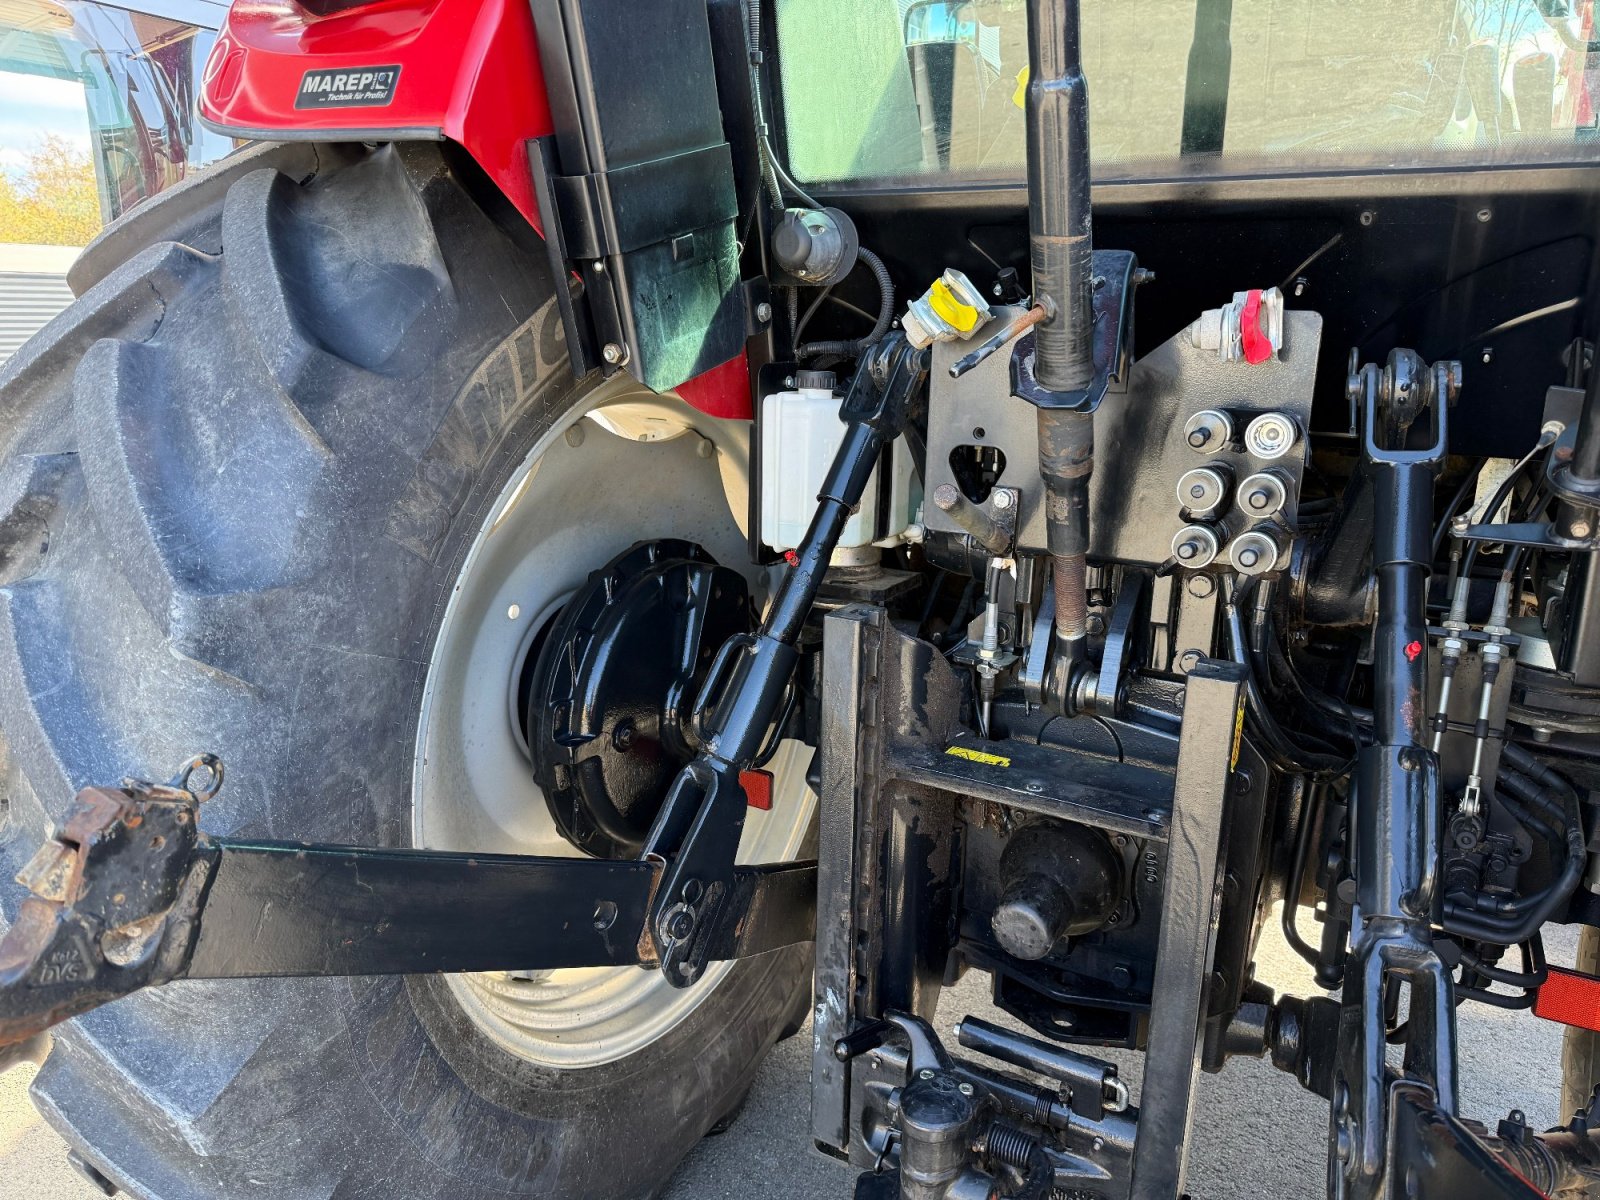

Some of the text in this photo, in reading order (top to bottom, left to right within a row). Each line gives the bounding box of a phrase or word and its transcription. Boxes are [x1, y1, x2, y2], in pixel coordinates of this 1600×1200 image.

[302, 73, 373, 93] MAREP
[327, 93, 353, 101] Technik
[353, 91, 364, 100] für
[364, 90, 388, 99] Profis!
